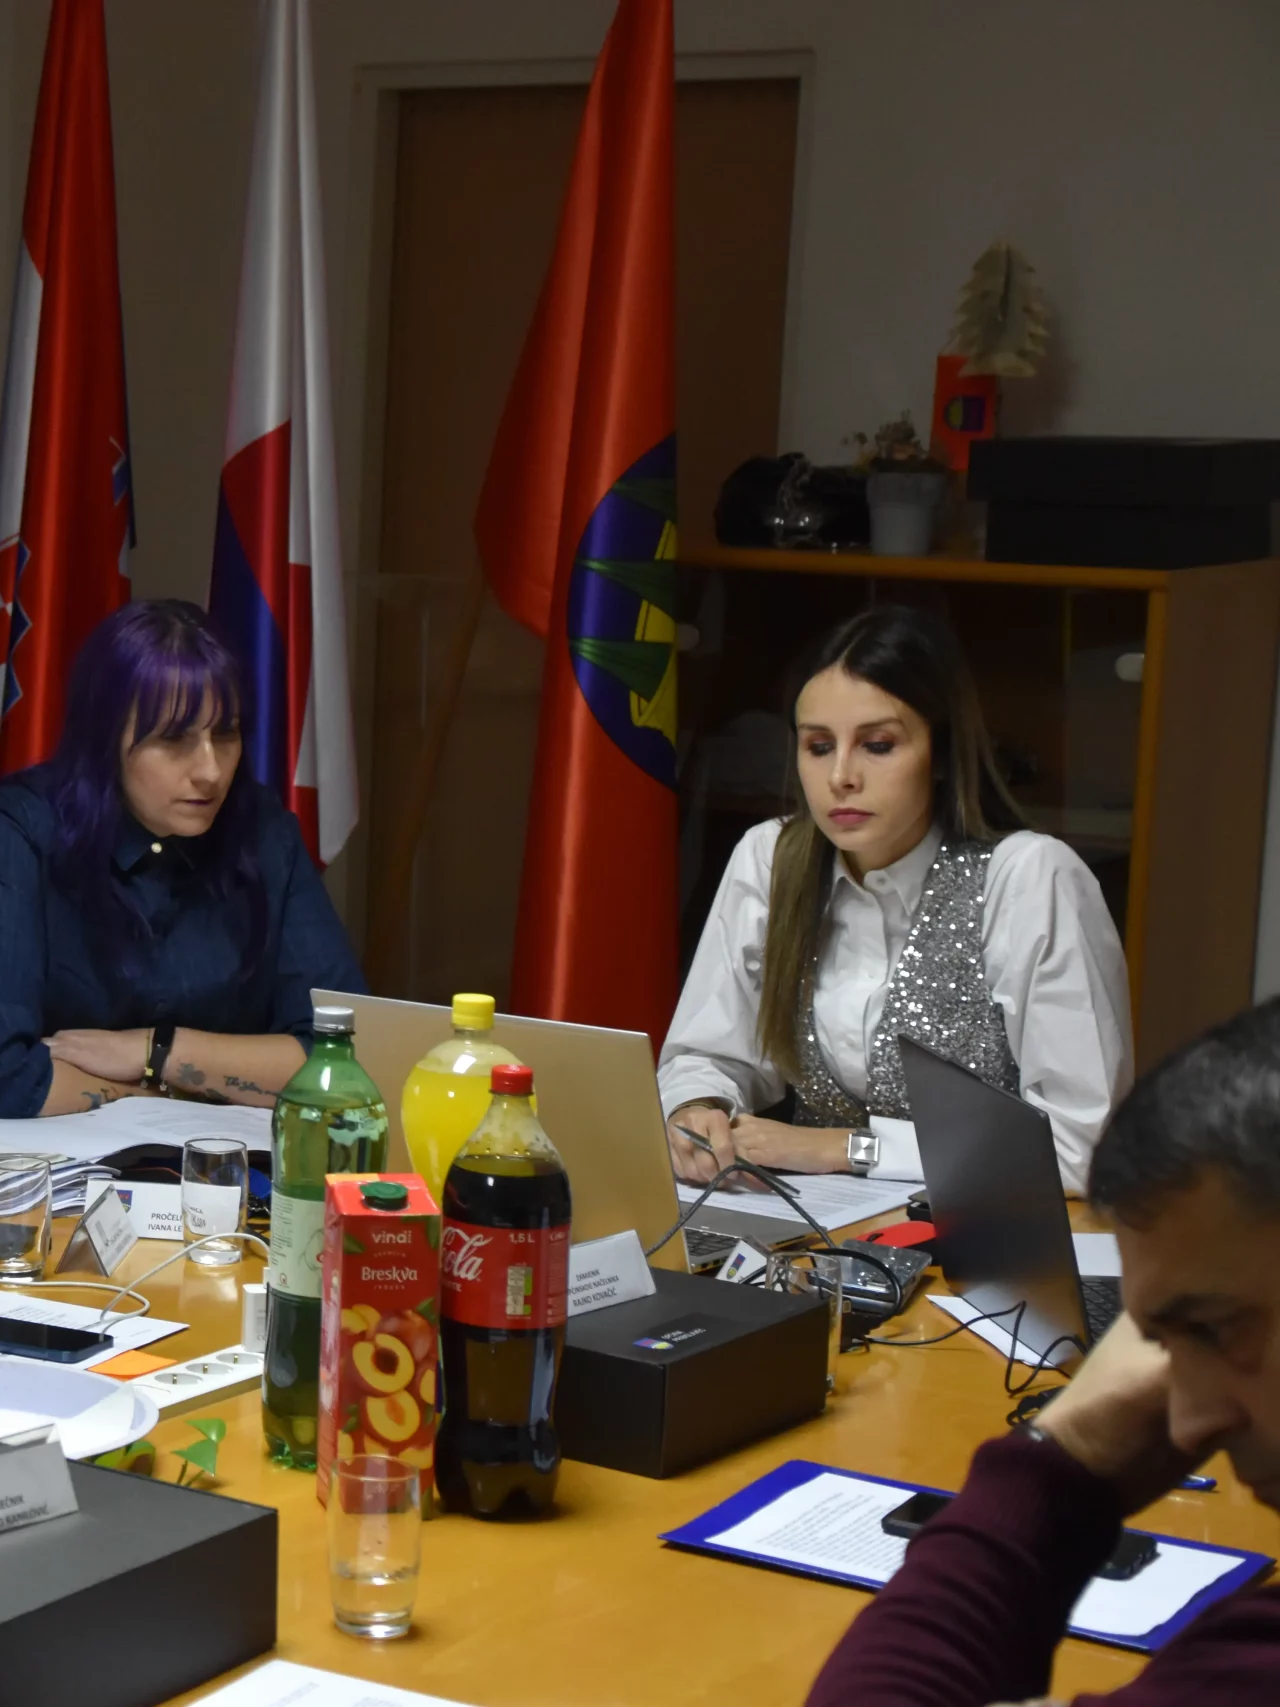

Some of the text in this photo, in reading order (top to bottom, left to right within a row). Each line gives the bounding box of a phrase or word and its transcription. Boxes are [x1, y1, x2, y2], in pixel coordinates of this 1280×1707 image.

[148, 1223, 172, 1232] IVANA
[372, 1229, 413, 1244] vindi
[361, 1265, 419, 1284] Breskva
